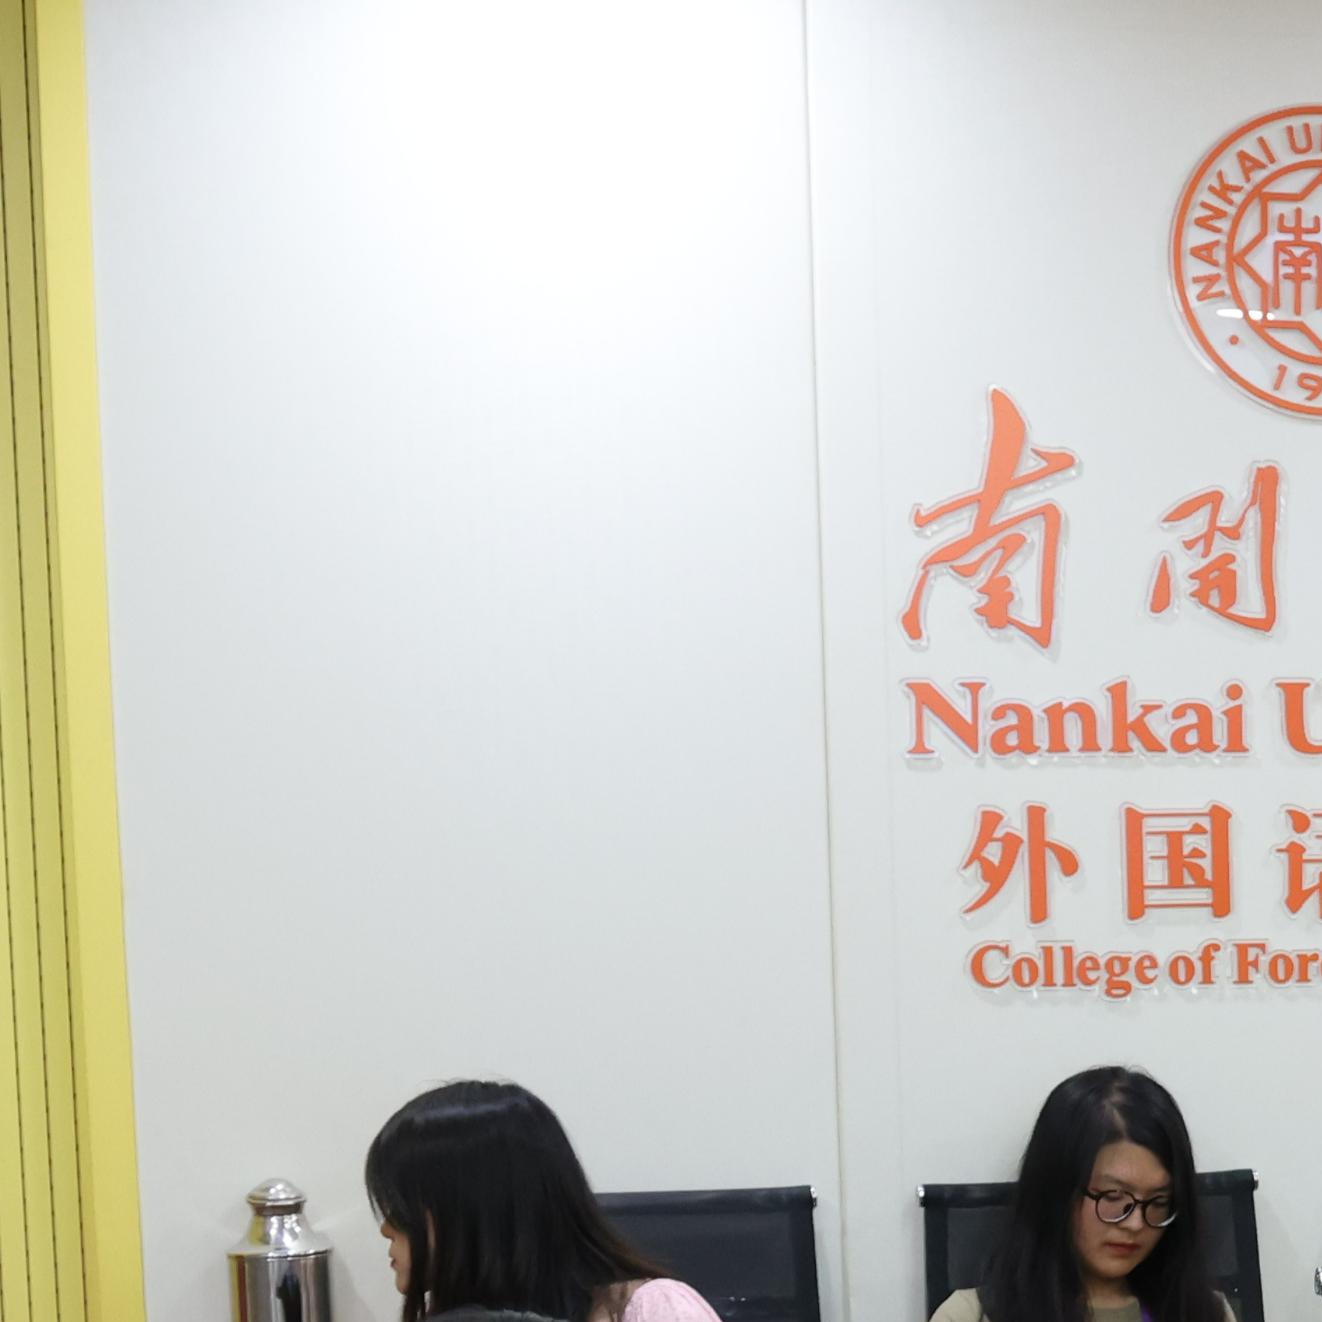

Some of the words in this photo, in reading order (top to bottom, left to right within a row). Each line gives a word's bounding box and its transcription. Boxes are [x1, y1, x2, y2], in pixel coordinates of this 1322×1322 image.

[1189, 136, 1277, 303] NANKAI
[904, 682, 1250, 755] Nankai
[970, 944, 1159, 997] College
[1168, 944, 1221, 985] of
